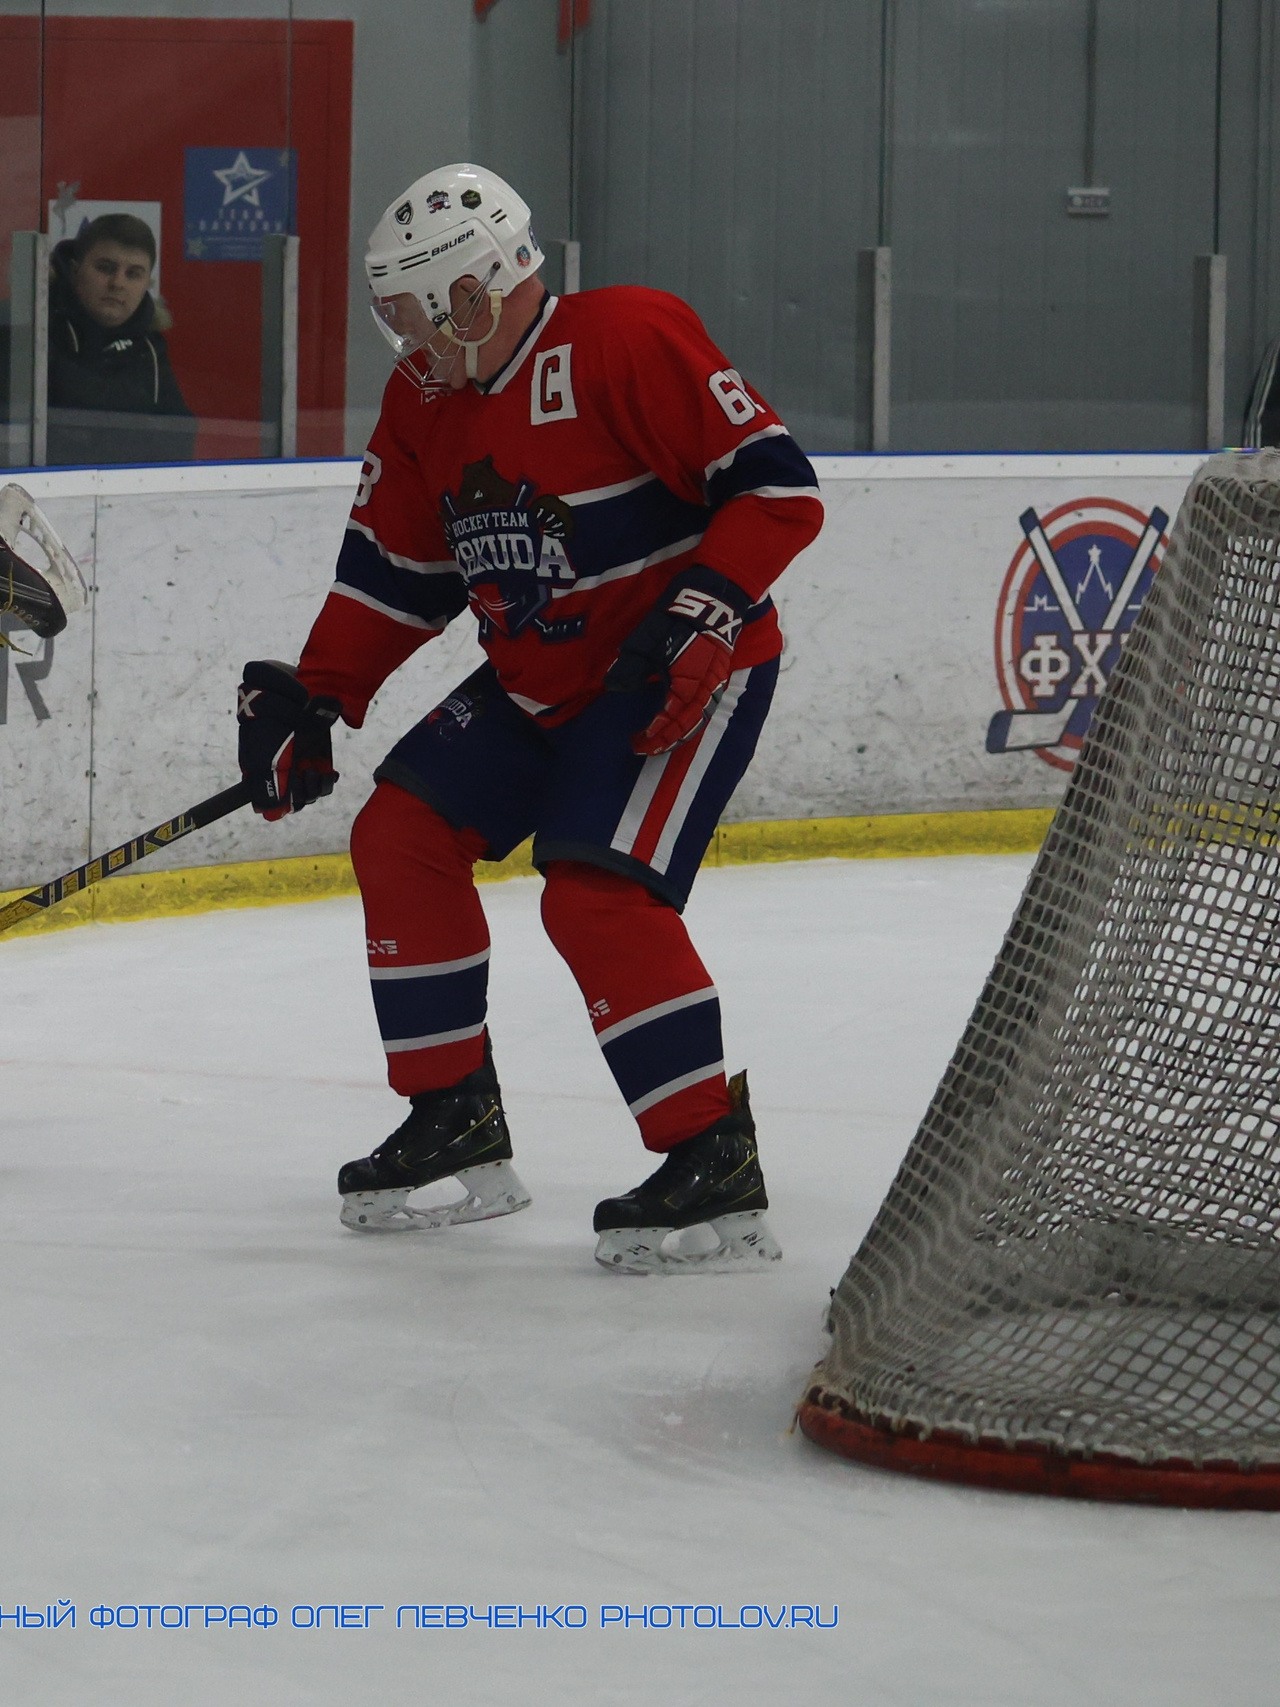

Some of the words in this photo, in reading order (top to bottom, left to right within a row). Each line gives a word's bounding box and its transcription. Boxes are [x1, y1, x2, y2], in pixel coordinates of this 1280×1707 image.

[540, 354, 563, 414] C
[492, 511, 529, 529] TEAM
[667, 587, 743, 644] STX
[1019, 632, 1131, 698] ФХ
